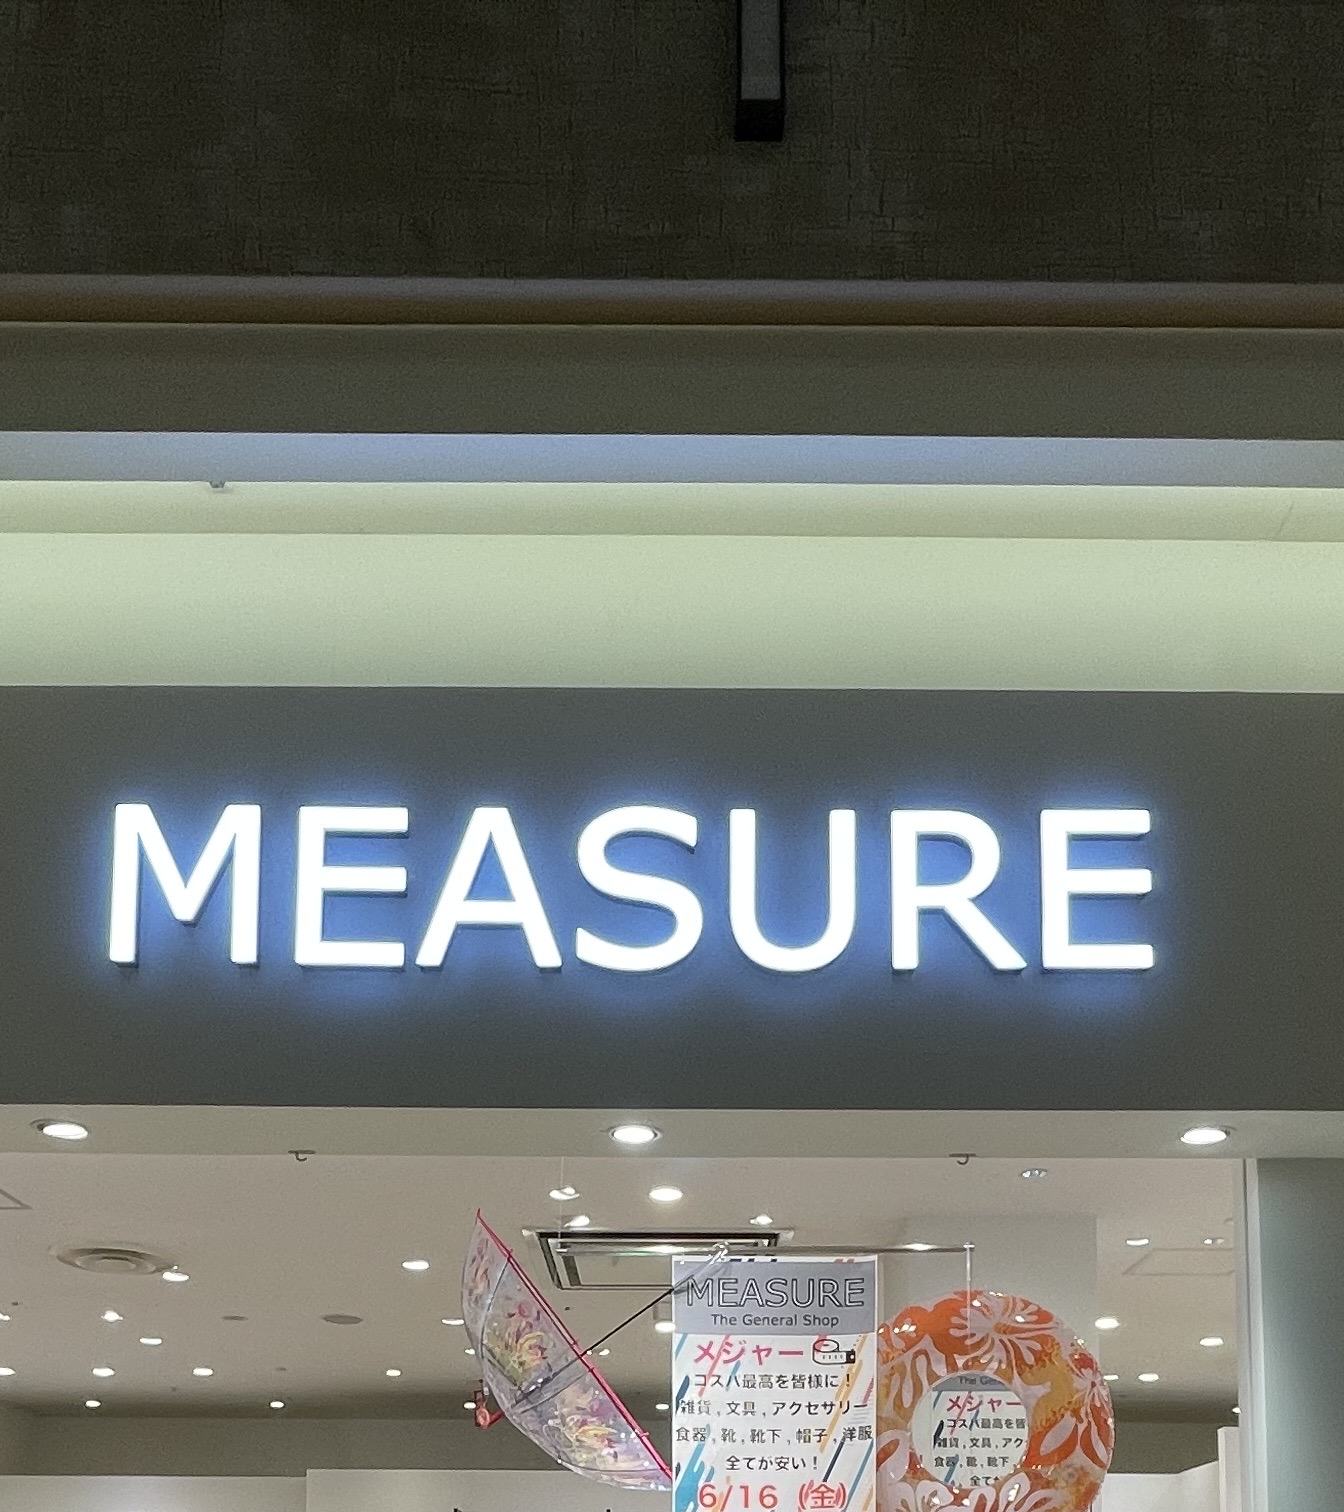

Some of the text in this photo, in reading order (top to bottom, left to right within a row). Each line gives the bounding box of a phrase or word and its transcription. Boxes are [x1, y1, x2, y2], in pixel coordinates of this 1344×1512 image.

[108, 802, 1155, 973] MEASURE
[686, 1277, 865, 1309] MEASURE
[711, 1314, 839, 1328] The General Shop
[694, 1340, 804, 1366] メジャー
[698, 1484, 778, 1512] 6/16
